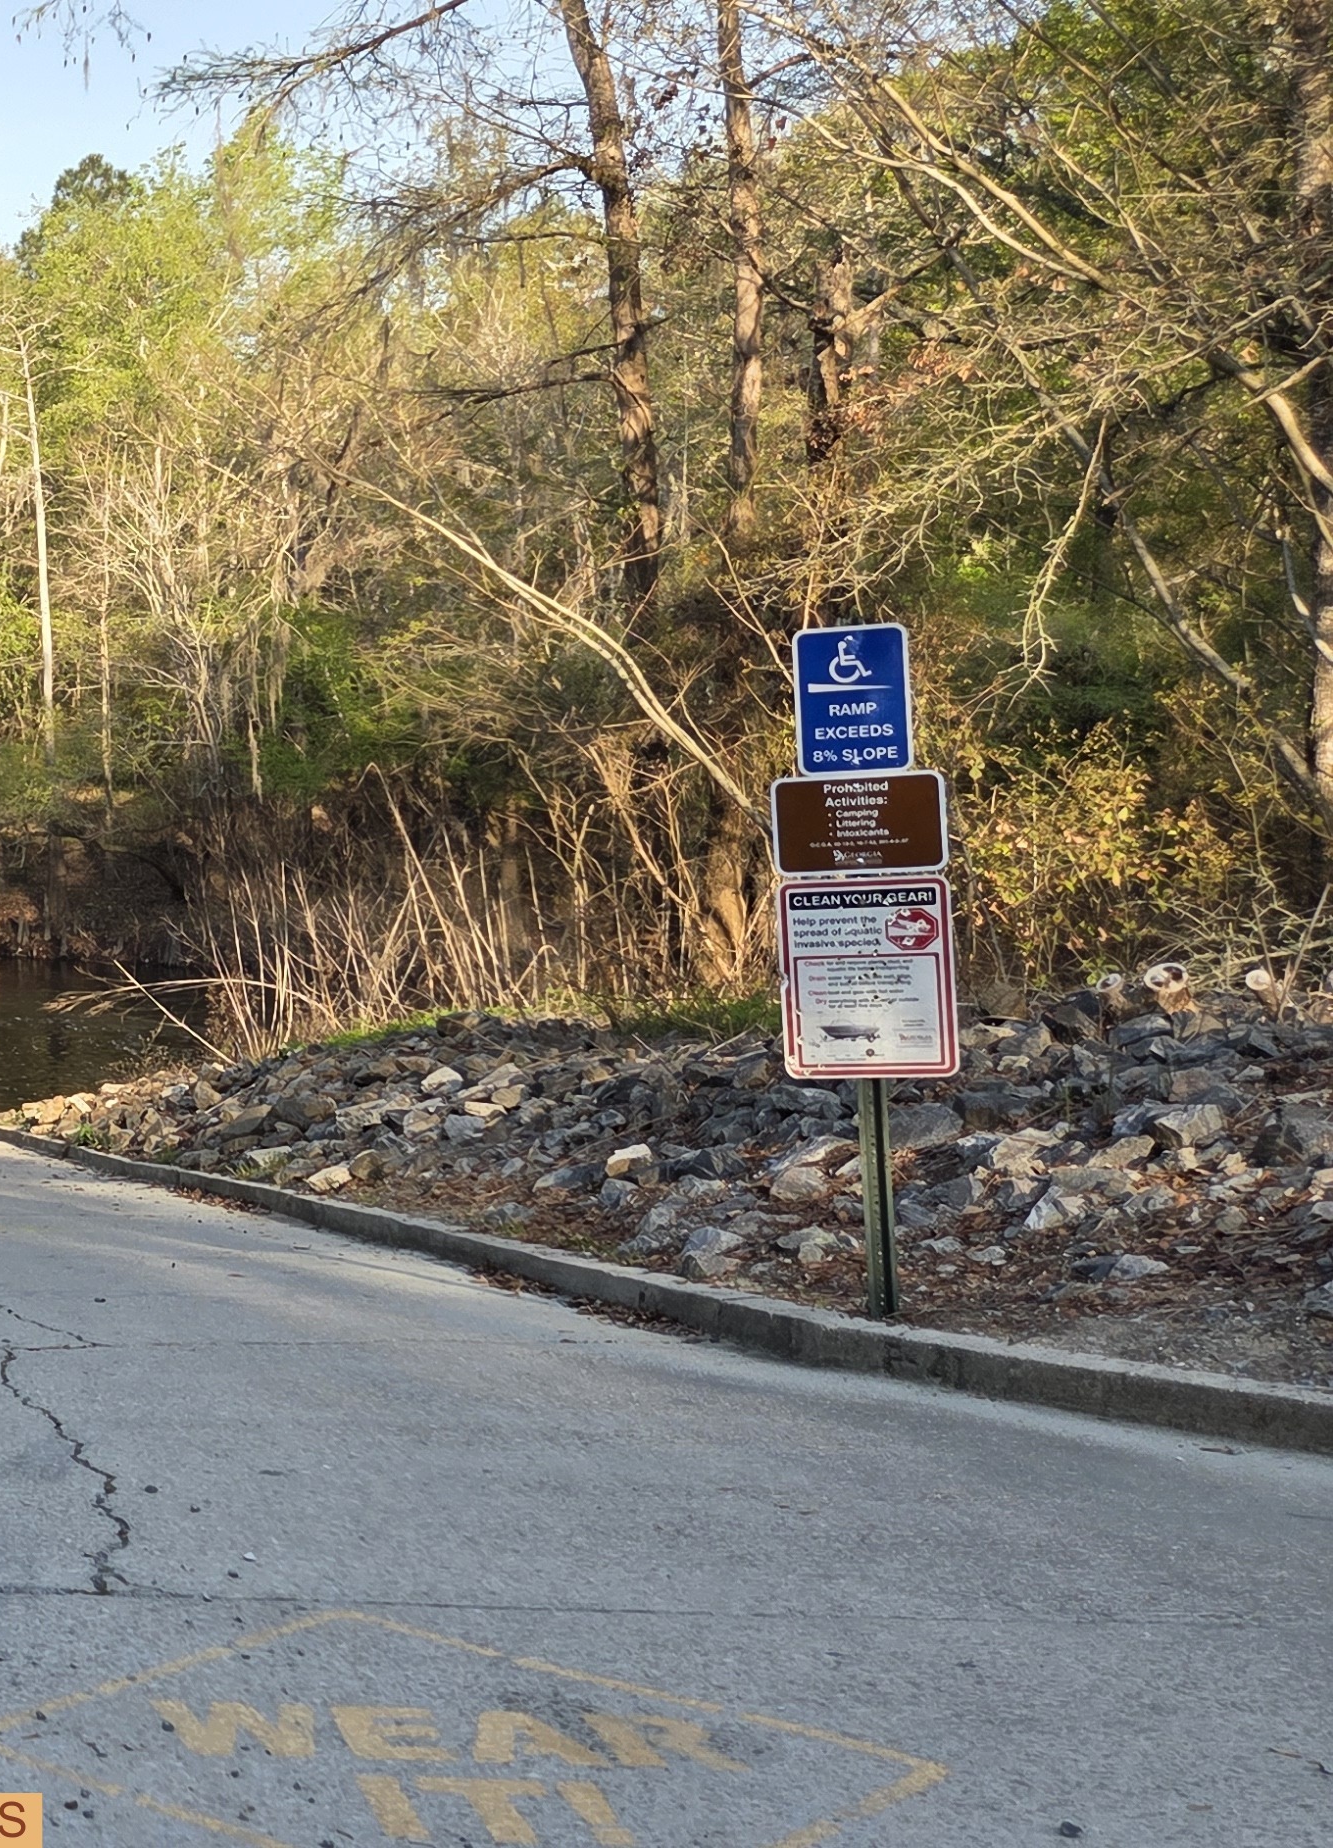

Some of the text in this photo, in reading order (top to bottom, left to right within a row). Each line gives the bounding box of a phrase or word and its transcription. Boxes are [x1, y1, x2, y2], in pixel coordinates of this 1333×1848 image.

[828, 702, 877, 717] RAMP
[814, 723, 894, 740] EXCEEDS
[812, 746, 899, 763] 8% SLOPE
[825, 796, 888, 808] Activities:
[835, 809, 879, 819] Camping
[836, 819, 876, 828] Littering
[836, 828, 890, 838] Intoxicants
[792, 891, 933, 907] CLEAN YOUR GEAR!
[792, 915, 877, 927] Help prevent the
[793, 928, 829, 938] spread
[831, 928, 841, 936] of
[794, 939, 836, 948] invasive
[149, 1697, 751, 1771] WEAR
[357, 1774, 635, 1848] IT!
